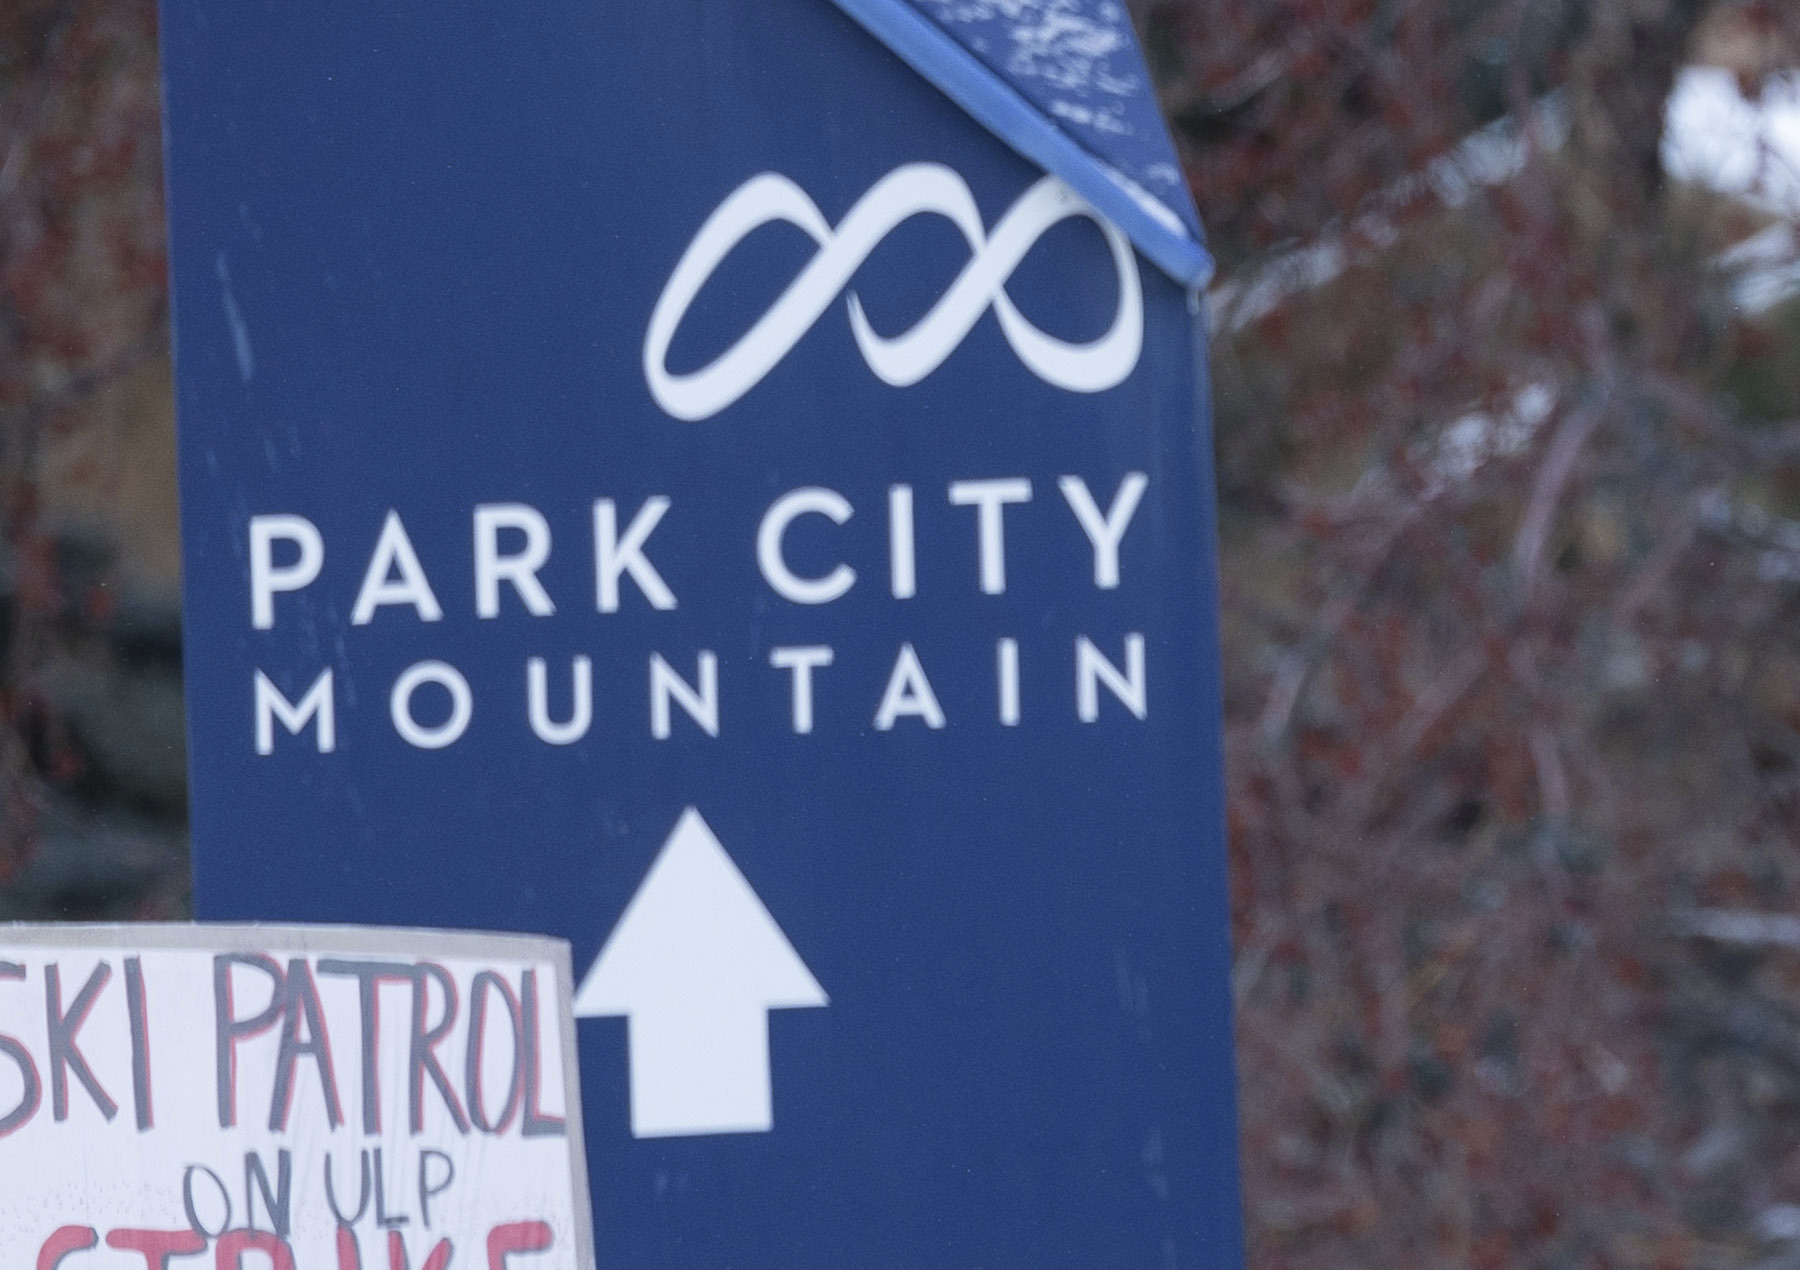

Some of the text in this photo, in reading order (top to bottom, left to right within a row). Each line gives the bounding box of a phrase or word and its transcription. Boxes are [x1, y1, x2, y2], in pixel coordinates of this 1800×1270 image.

[248, 472, 1149, 631] PARK CITY
[254, 633, 1148, 756] MOUNTAIN
[214, 954, 568, 1137] PATROL
[182, 1147, 455, 1240] ON ULP
